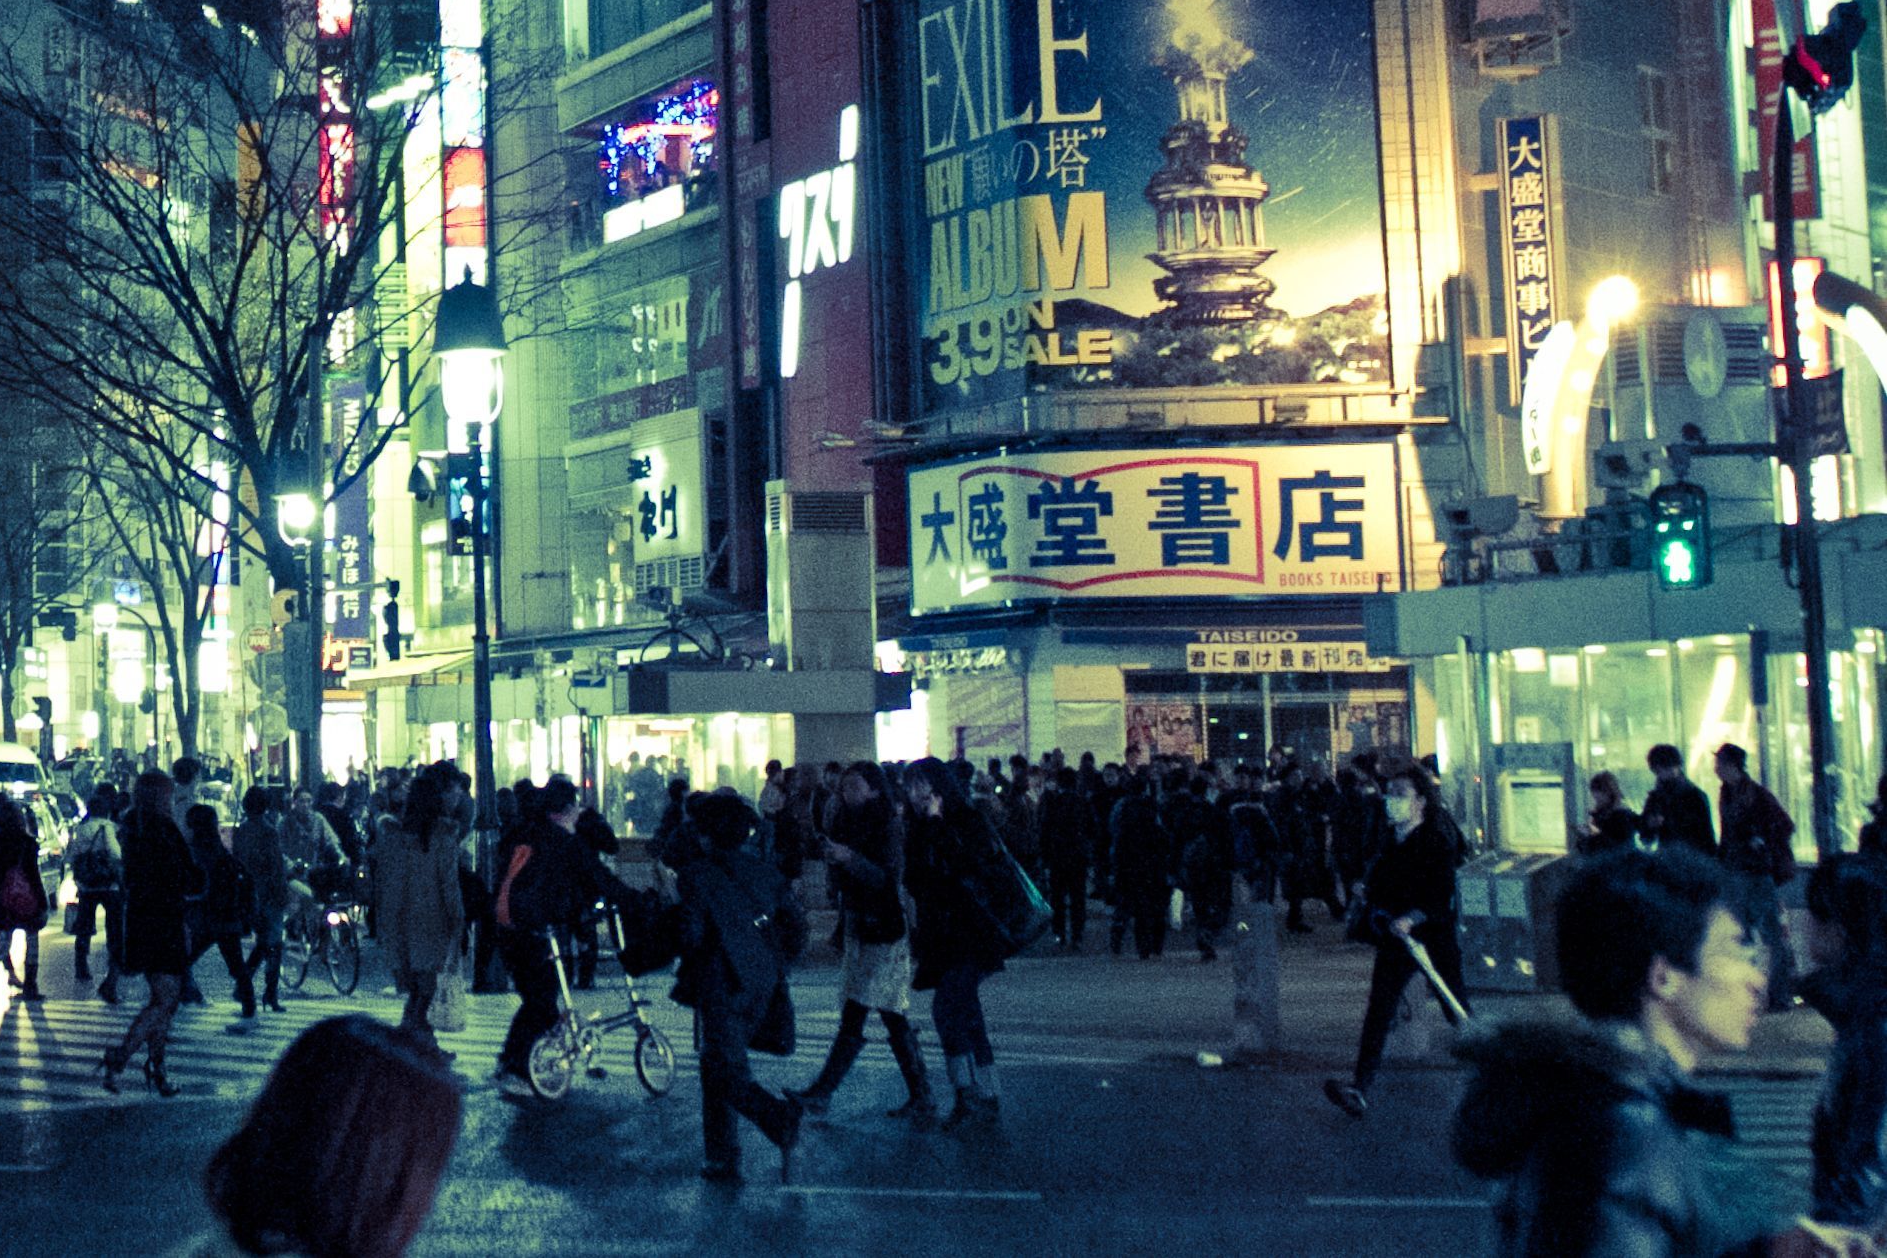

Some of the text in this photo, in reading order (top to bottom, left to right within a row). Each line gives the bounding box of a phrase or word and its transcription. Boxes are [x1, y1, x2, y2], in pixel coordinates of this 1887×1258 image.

[924, 153, 965, 218] NEW
[929, 191, 1110, 314] ALBUM
[1002, 298, 1056, 334] ON
[930, 307, 1003, 387] 3.9
[1002, 328, 1114, 371] SALE
[919, 469, 1367, 582] 大盛堂書店
[1278, 572, 1324, 588] BOOKS
[1196, 629, 1300, 644] TAISEIDO
